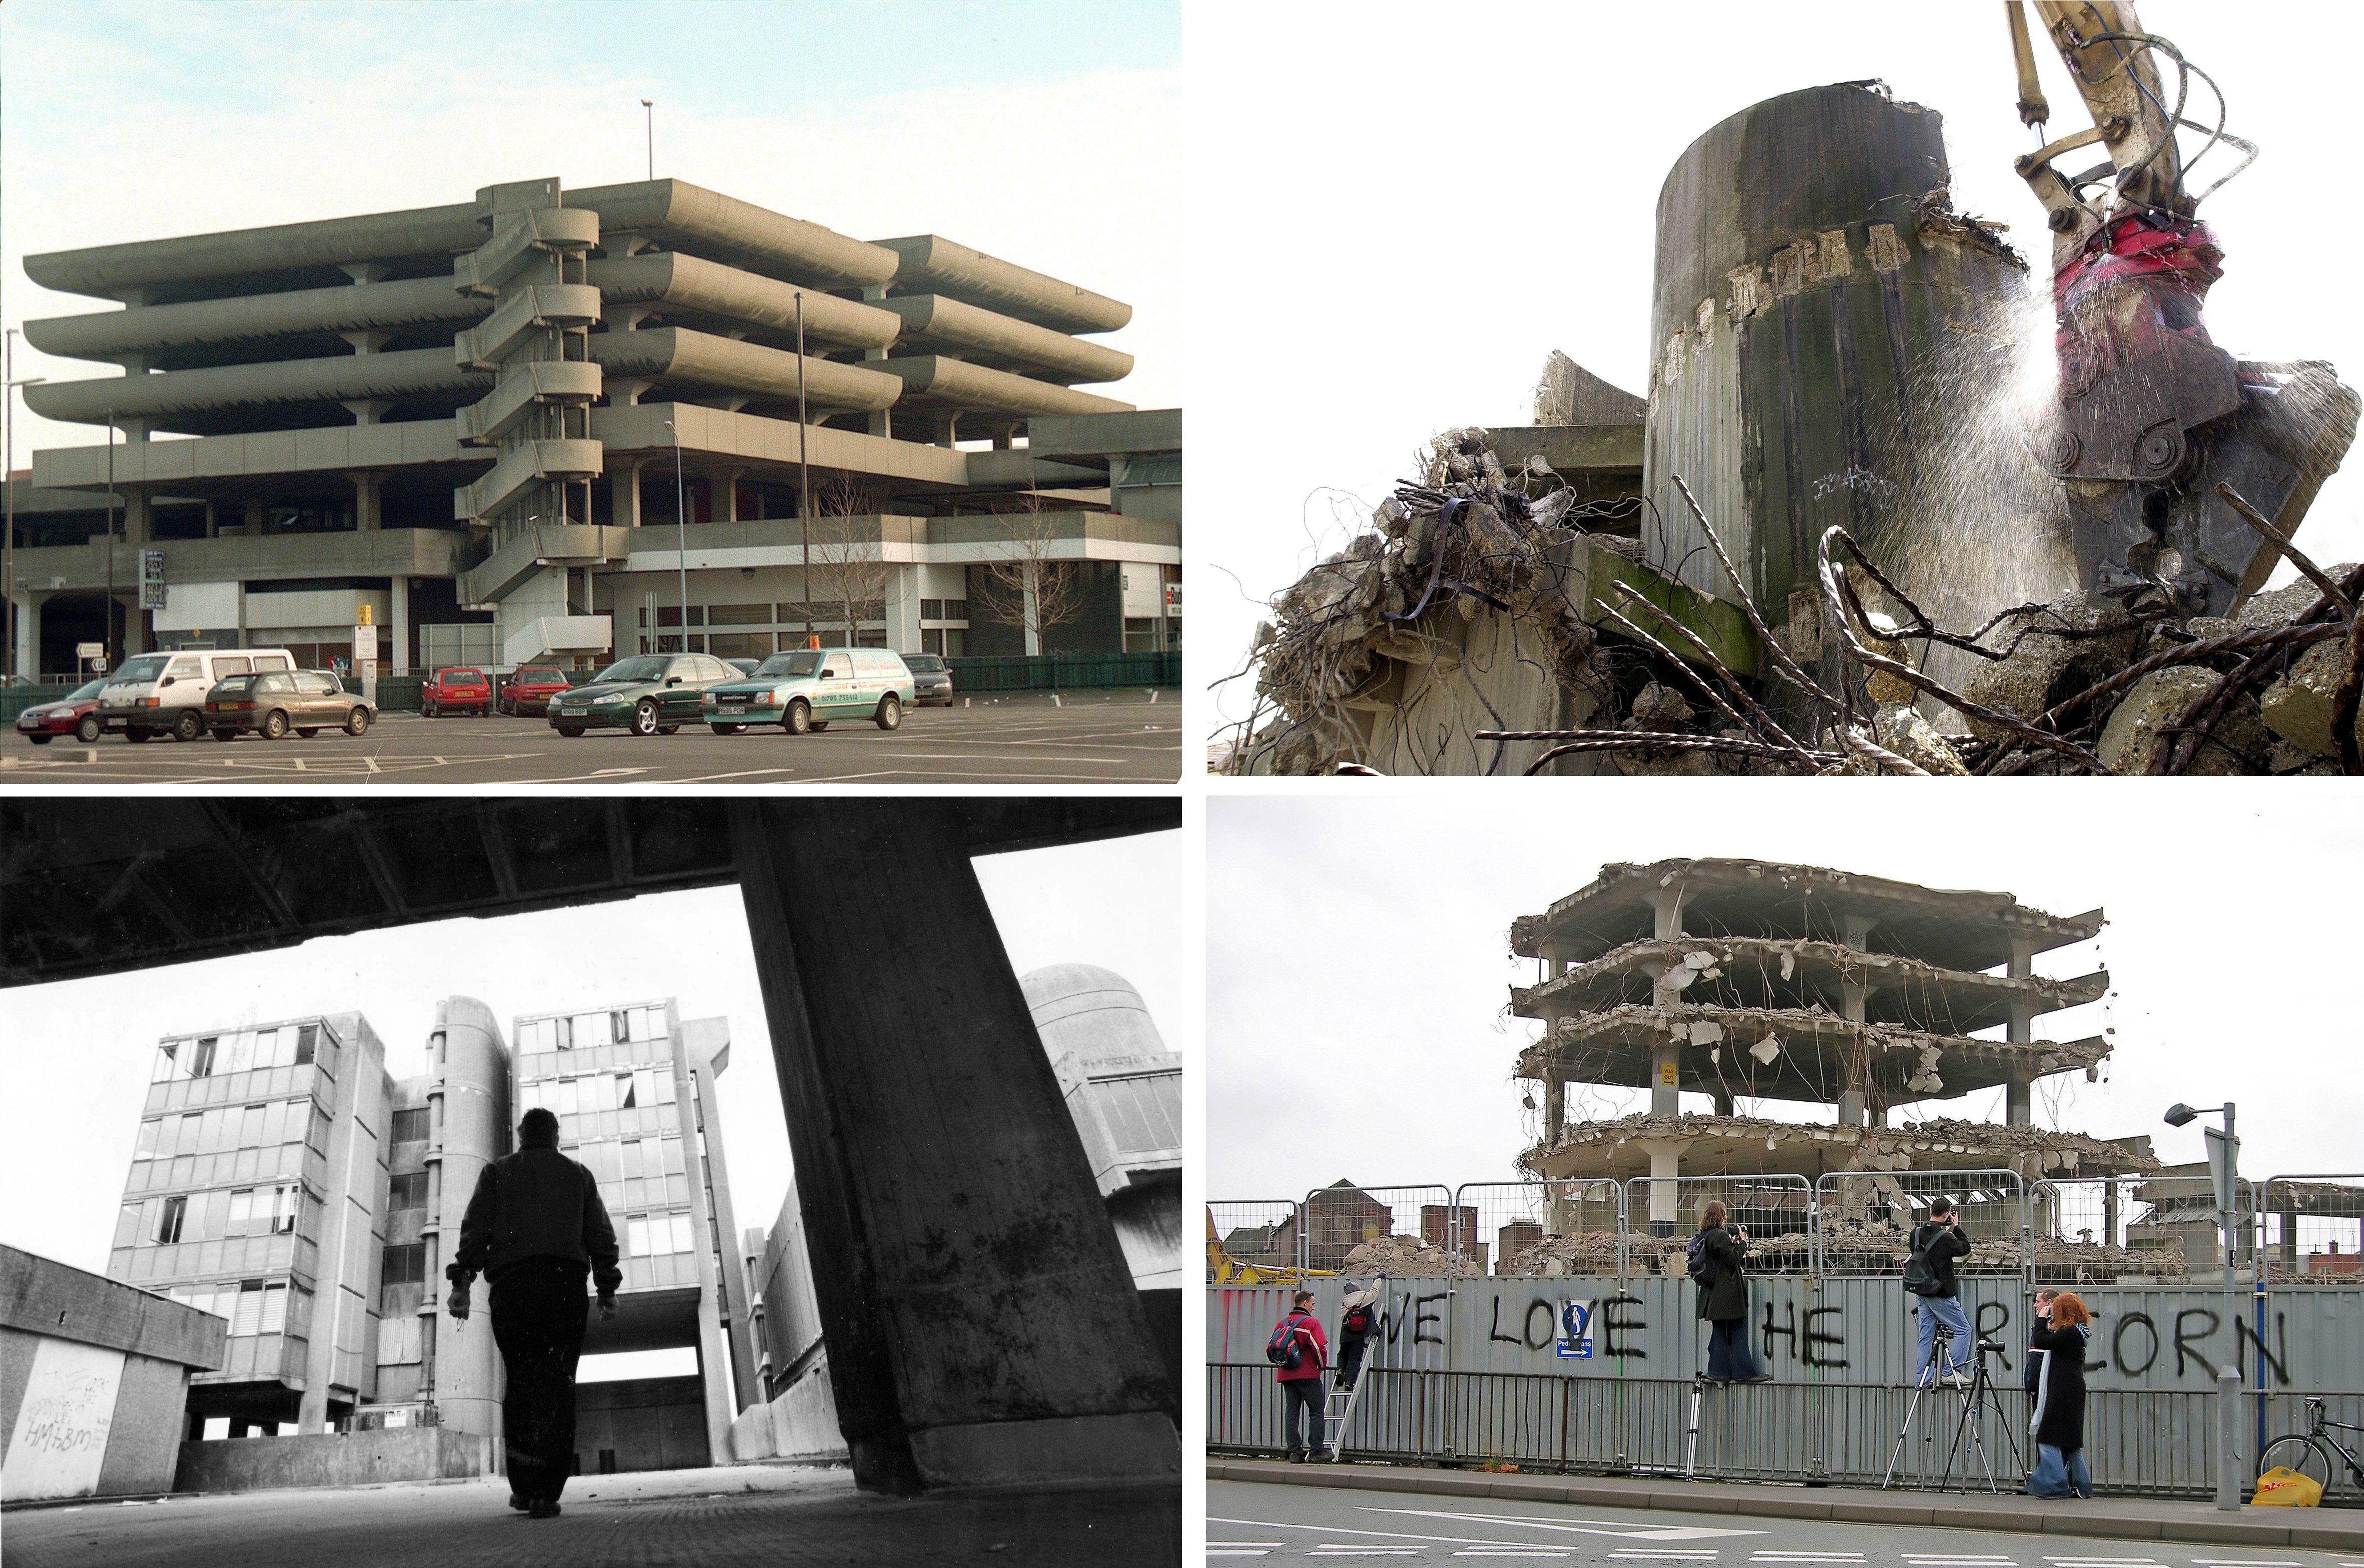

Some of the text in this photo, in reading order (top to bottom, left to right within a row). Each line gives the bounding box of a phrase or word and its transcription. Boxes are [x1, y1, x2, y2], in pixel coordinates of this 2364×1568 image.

[1379, 1292, 1447, 1344] WE
[1491, 1295, 1648, 1359] LOVE
[1761, 1300, 1850, 1369] HE
